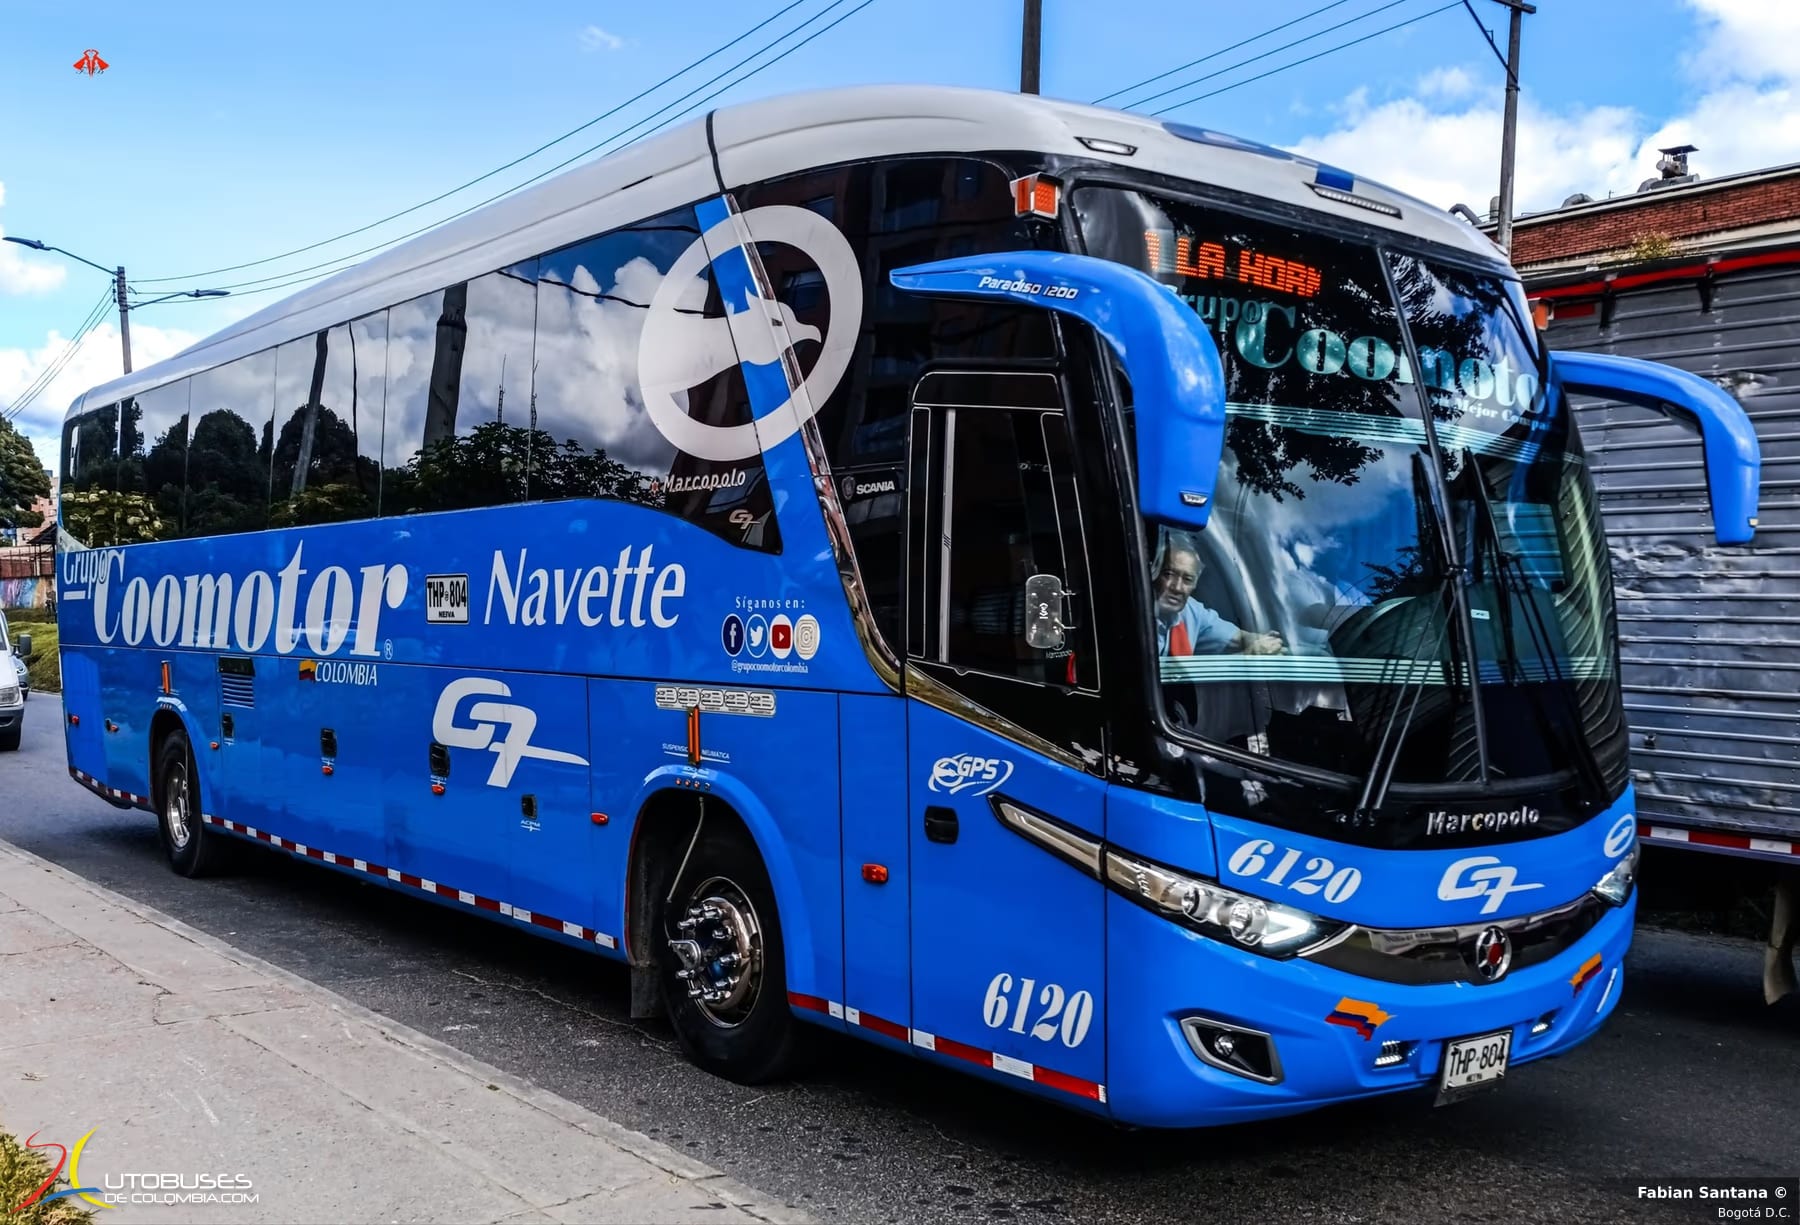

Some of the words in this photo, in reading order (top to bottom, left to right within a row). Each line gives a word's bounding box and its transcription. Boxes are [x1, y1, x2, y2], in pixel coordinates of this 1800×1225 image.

[1176, 236, 1226, 279] LA
[978, 276, 1042, 294] Paradiso
[1043, 285, 1079, 299] 1200
[1164, 284, 1264, 333] rupo
[662, 468, 746, 493] Marcopolo
[856, 480, 895, 495] SCANIA
[63, 547, 107, 600] Grupo
[484, 544, 686, 628] Navette
[94, 539, 408, 656] Coomotor
[735, 596, 781, 612] Síganos
[785, 600, 806, 609] en:
[314, 661, 378, 686] COLOMBIA
[957, 755, 1000, 780] GPS
[1426, 805, 1540, 835] Marcopolo
[1228, 839, 1363, 904] 6120
[983, 973, 1093, 1048] 6120
